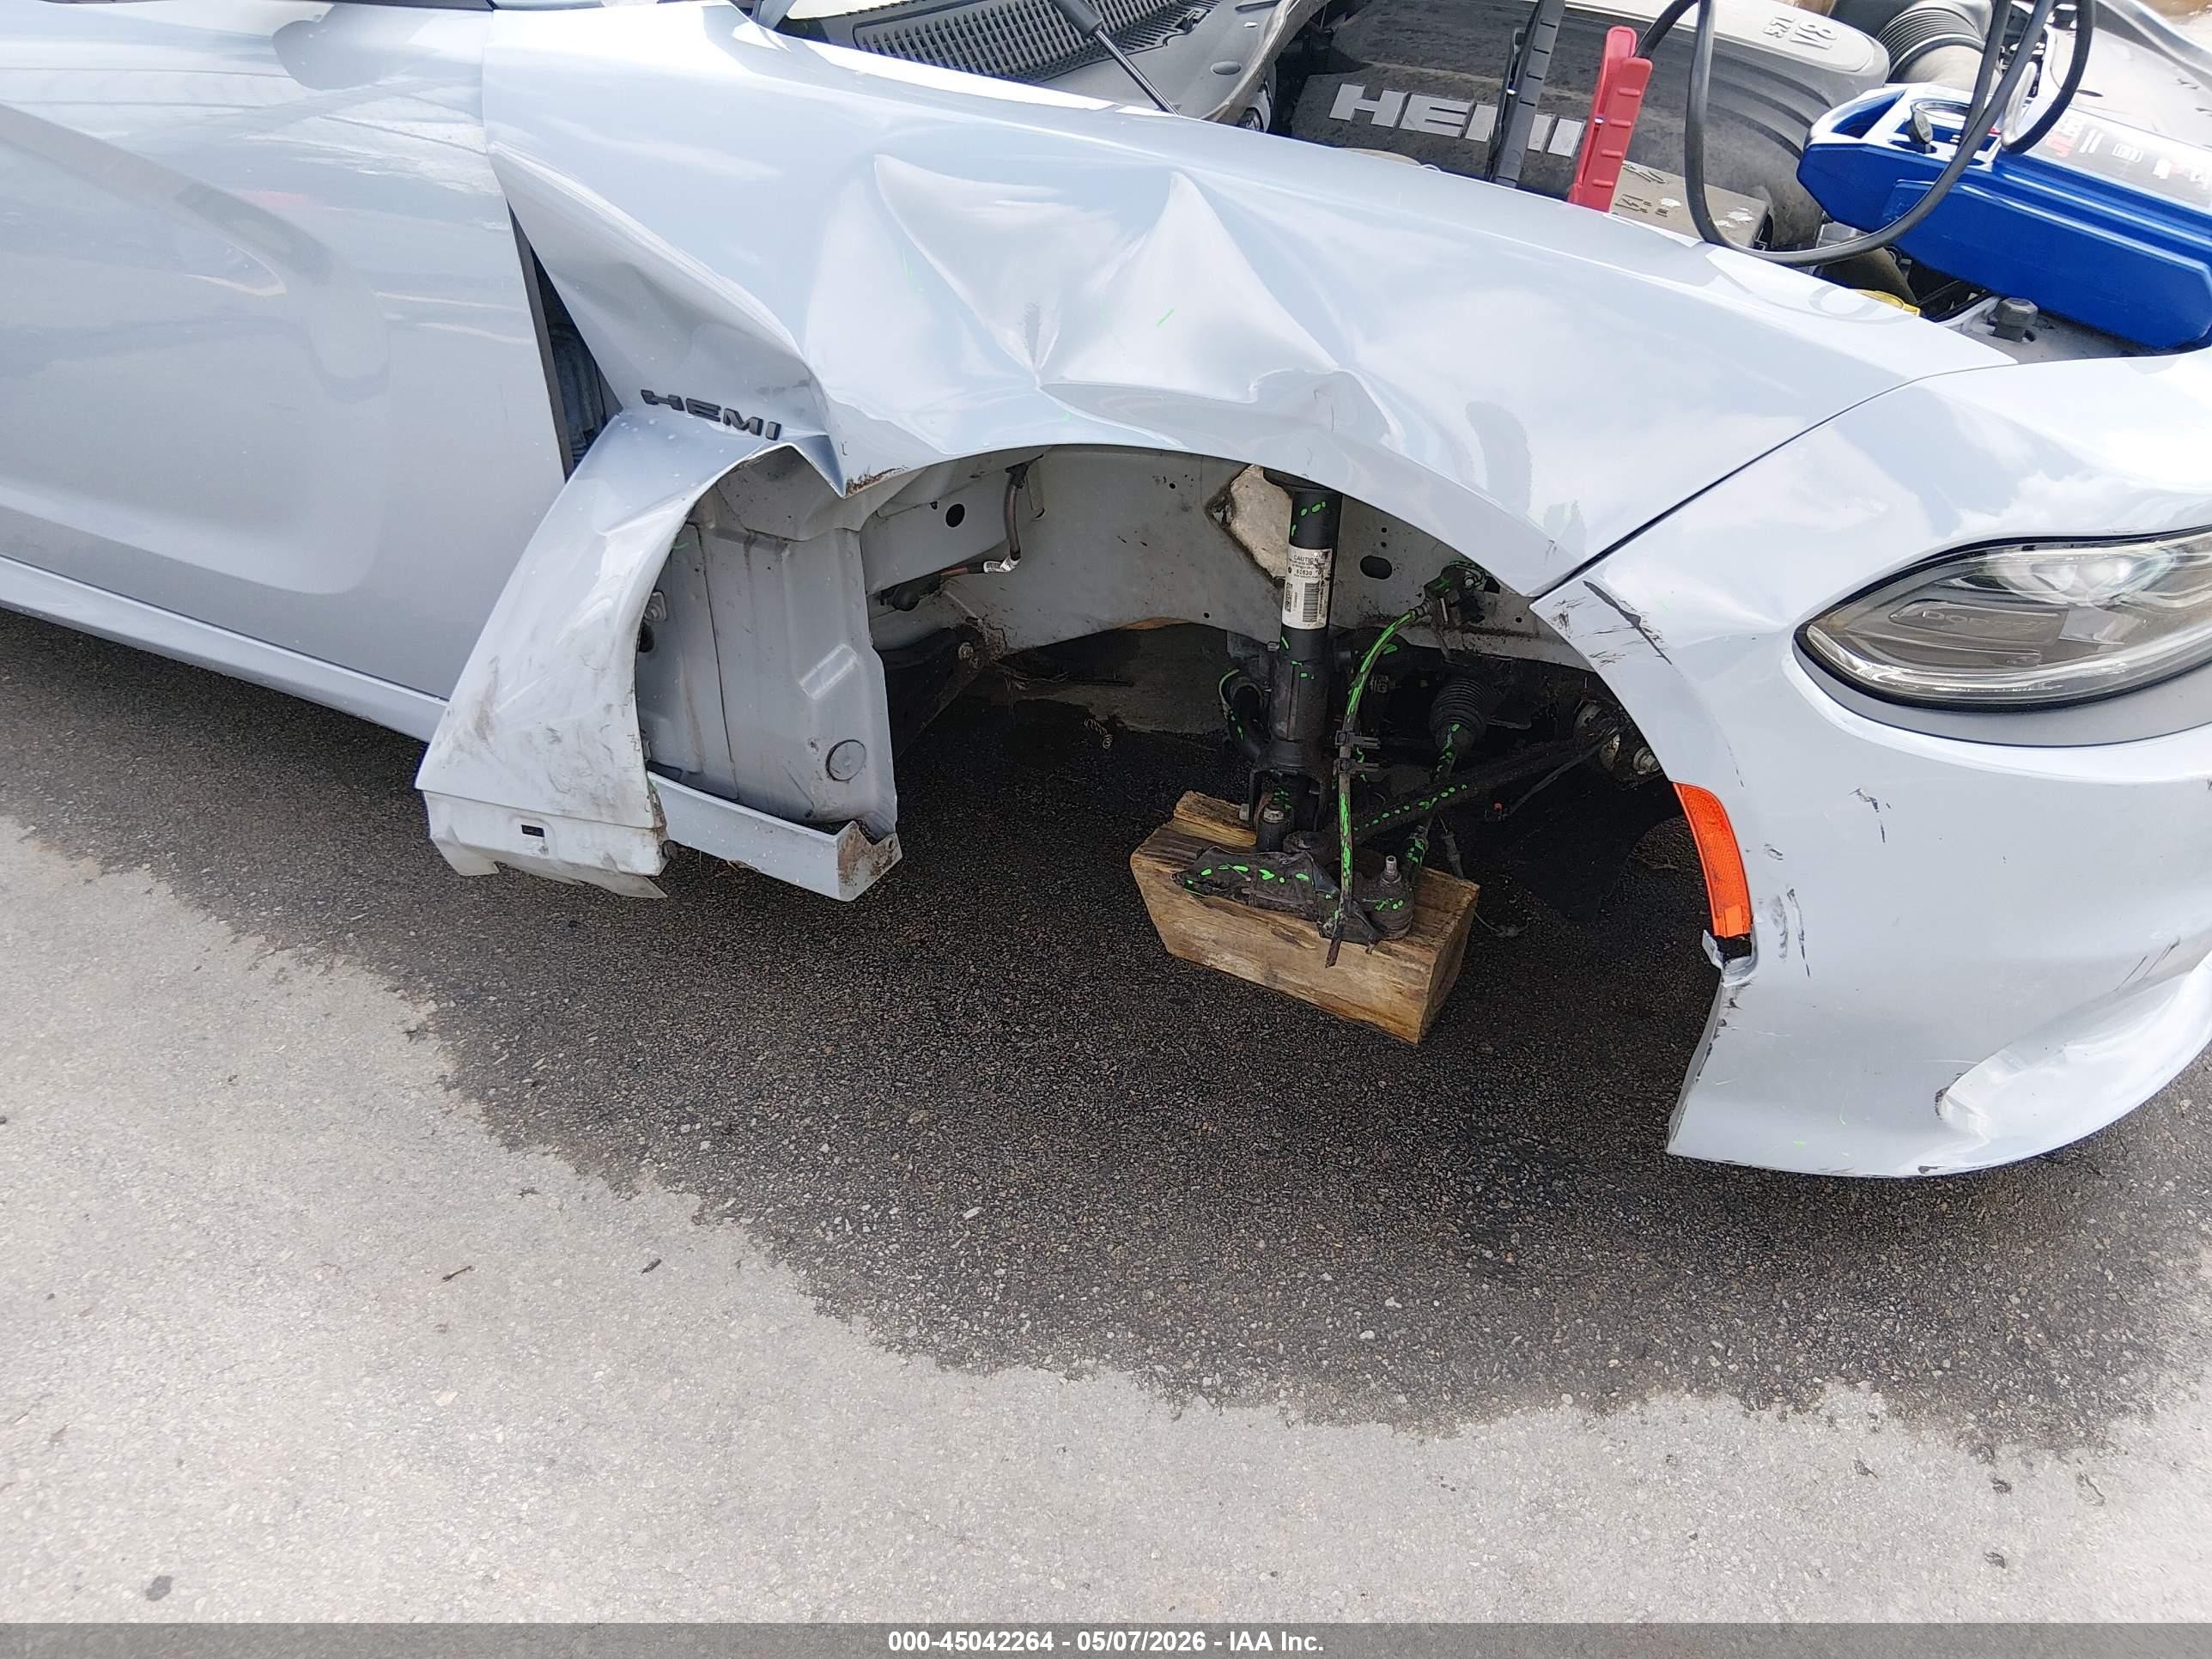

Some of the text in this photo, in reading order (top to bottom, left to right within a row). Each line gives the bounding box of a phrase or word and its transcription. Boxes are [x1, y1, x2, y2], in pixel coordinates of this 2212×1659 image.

[1788, 21, 1841, 50] V8
[641, 388, 782, 441] HEMI
[1293, 555, 1319, 564] CAUTION
